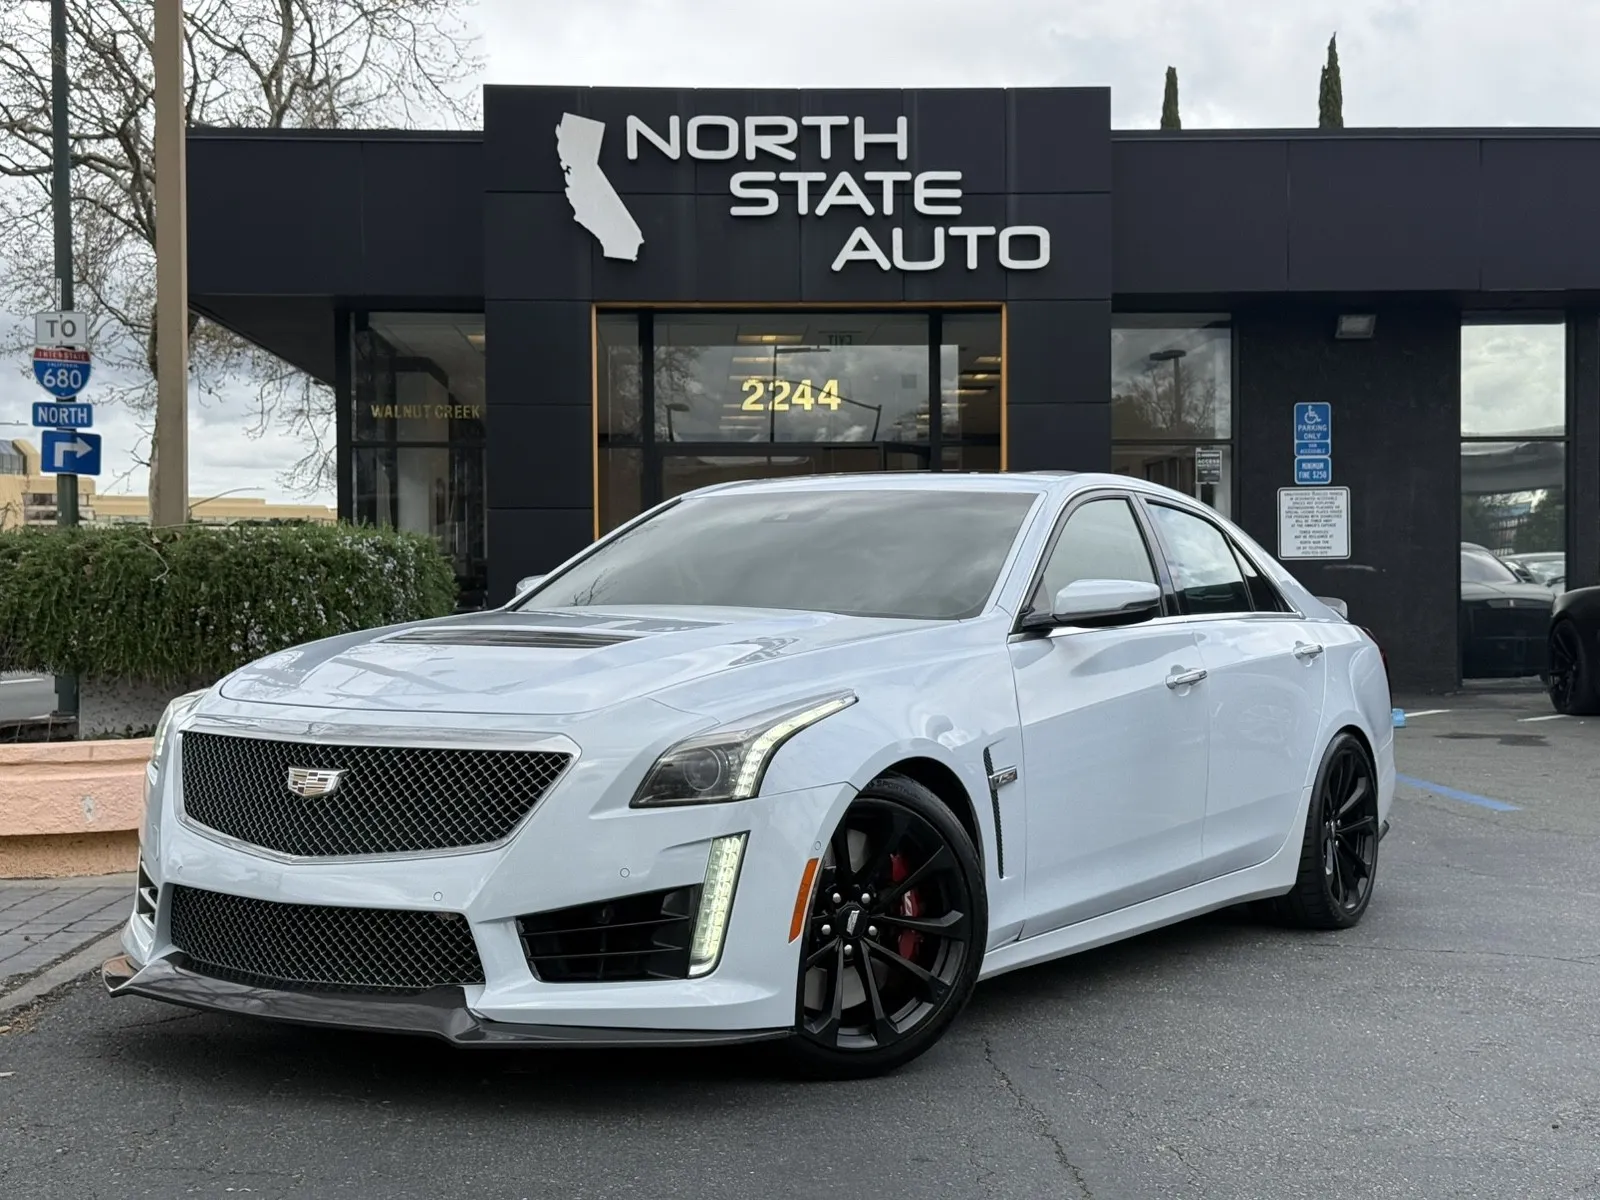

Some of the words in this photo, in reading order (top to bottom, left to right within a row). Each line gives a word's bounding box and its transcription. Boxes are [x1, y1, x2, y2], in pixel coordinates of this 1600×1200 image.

[626, 114, 908, 162] NORTH
[729, 170, 963, 217] STATE
[831, 225, 1051, 272] AUTO
[45, 319, 77, 339] TO
[43, 368, 82, 389] 680
[741, 379, 842, 411] 2244
[37, 406, 88, 424] NORTH
[370, 404, 431, 419] WALNUT
[434, 404, 480, 419] CREEK
[1297, 424, 1328, 432] PARKING
[1303, 432, 1322, 440] ONLY
